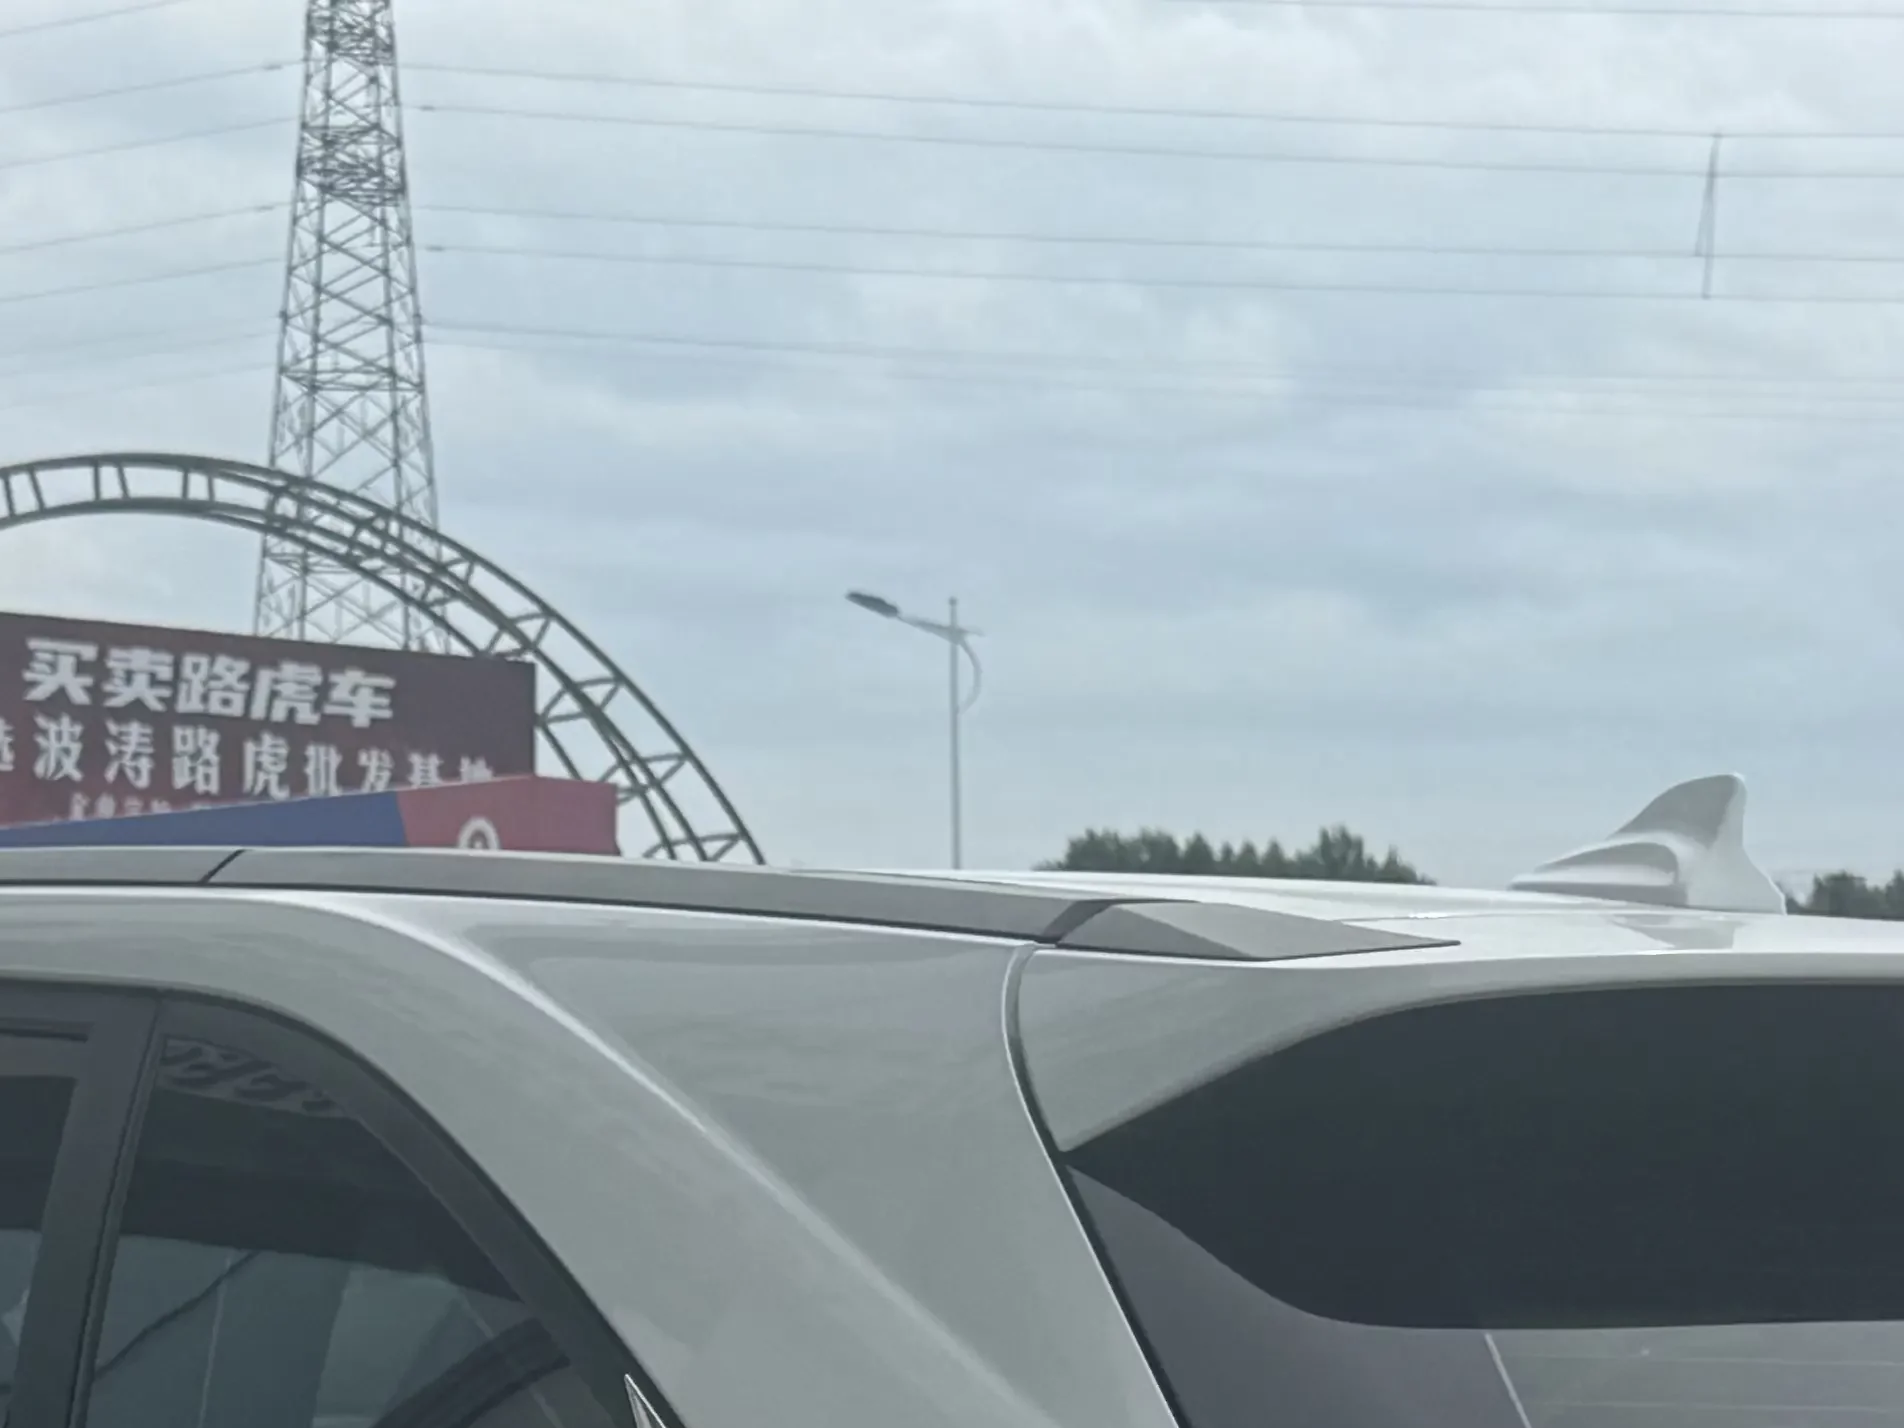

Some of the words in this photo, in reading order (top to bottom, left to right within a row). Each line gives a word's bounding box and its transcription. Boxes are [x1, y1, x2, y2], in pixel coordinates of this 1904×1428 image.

[22, 637, 396, 728] 买卖路虎车
